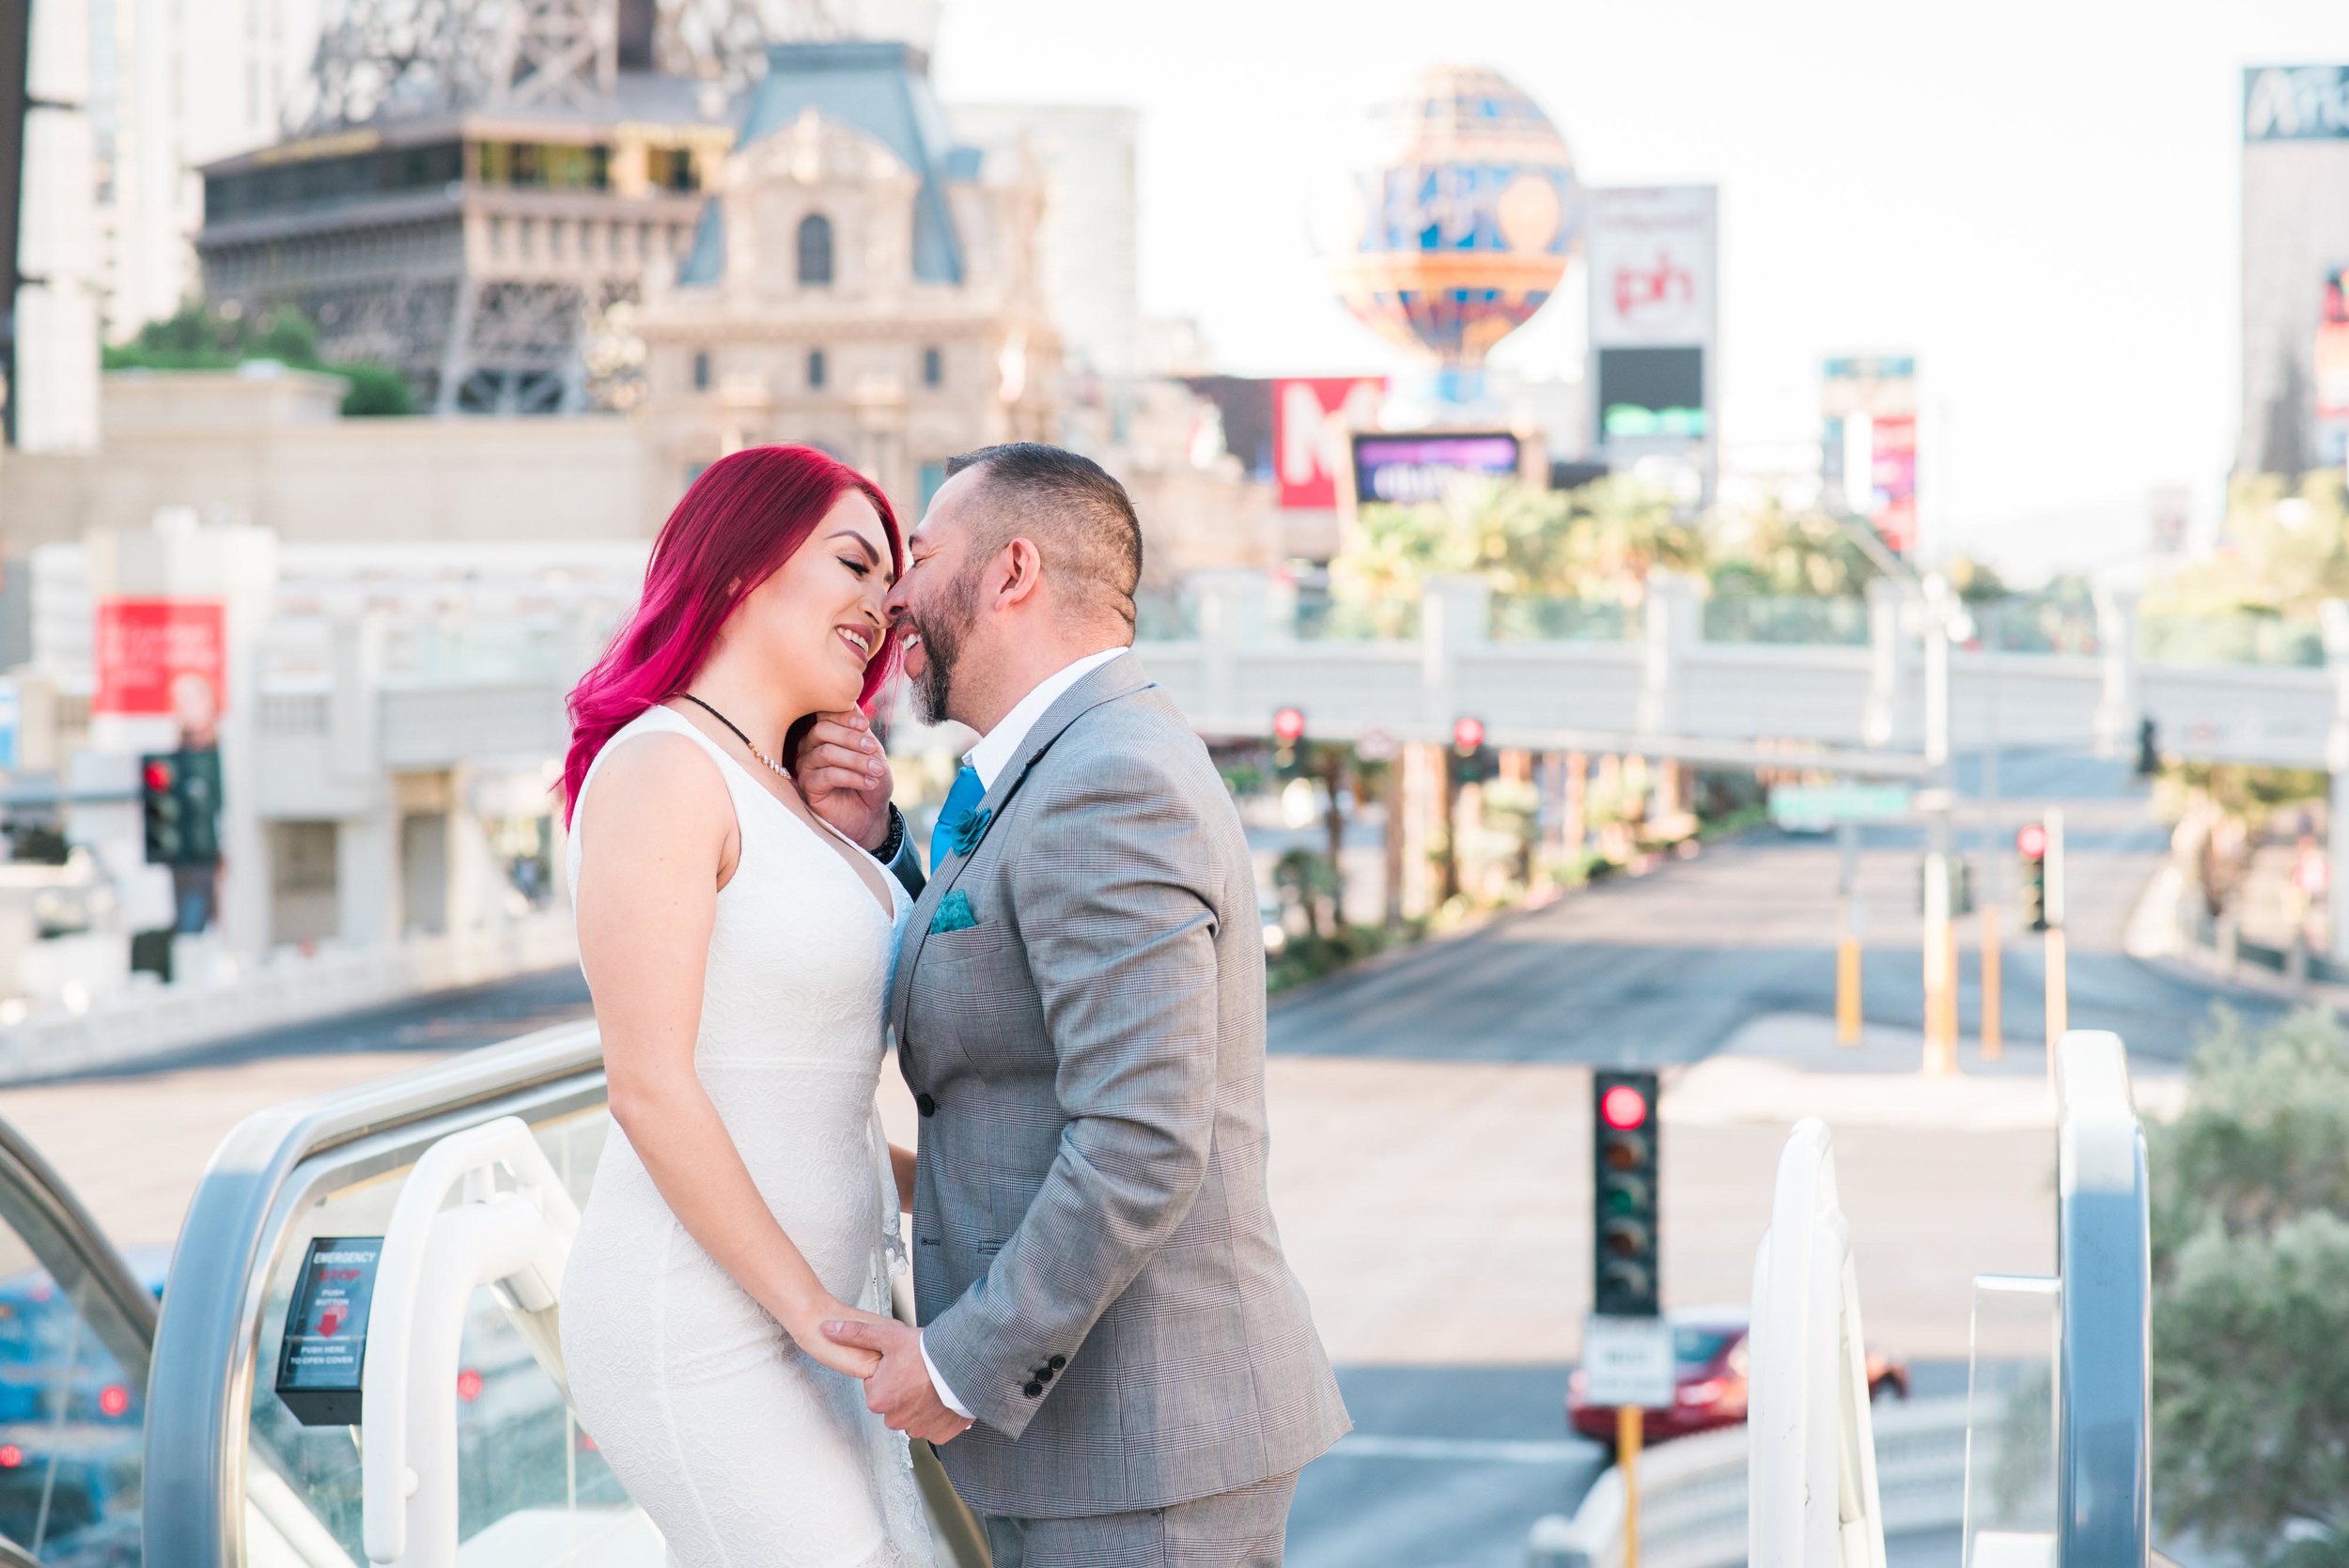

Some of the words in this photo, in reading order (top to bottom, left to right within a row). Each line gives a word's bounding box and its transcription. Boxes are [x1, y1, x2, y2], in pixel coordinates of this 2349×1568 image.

[313, 1251, 376, 1264] EMERGENCY
[318, 1268, 361, 1281] STOP
[301, 1345, 323, 1354] PUSH
[290, 1357, 301, 1365] TO
[303, 1357, 324, 1365] OPEN
[326, 1356, 354, 1364] COVER
